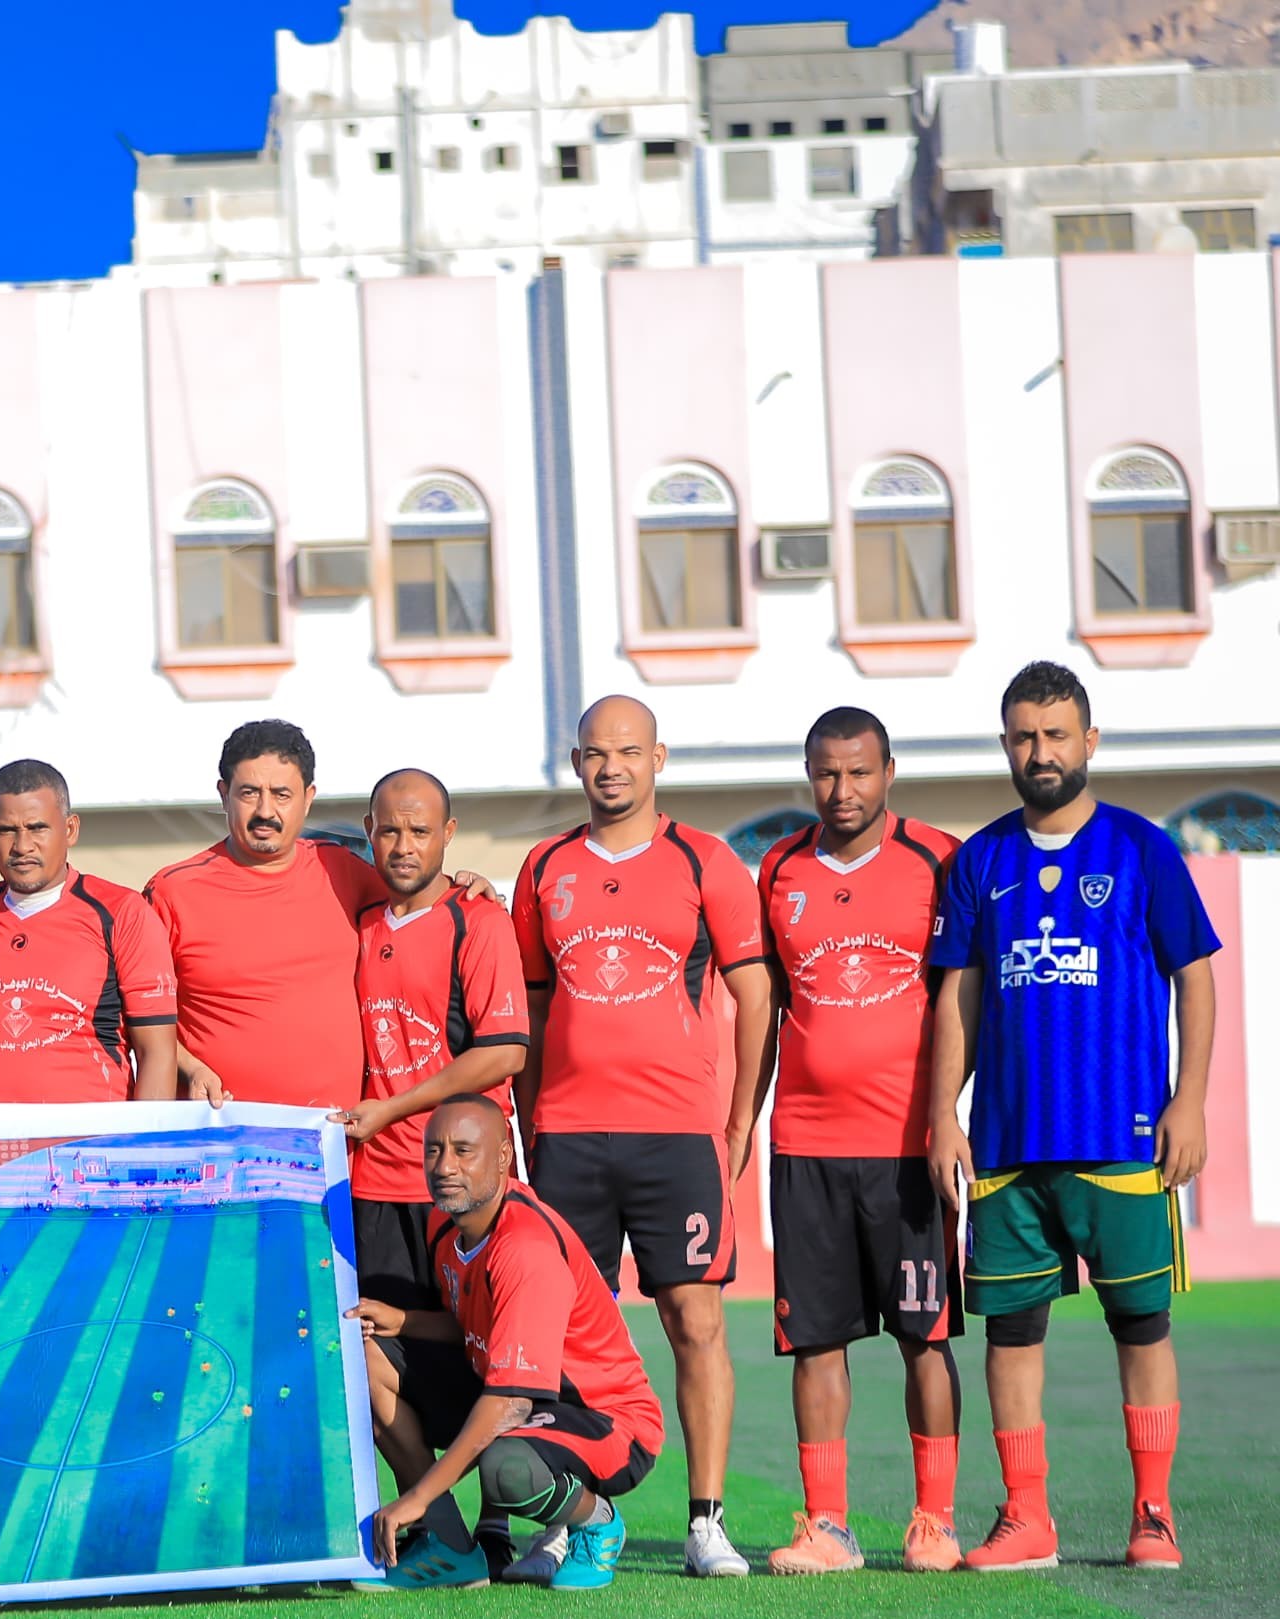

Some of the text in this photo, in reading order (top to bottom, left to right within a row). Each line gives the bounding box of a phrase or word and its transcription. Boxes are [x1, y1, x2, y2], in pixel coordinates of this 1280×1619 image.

[550, 874, 577, 921] 5
[787, 891, 807, 924] 7
[588, 925, 631, 941] الجوهرة
[828, 933, 870, 952] الجوهرة
[35, 978, 87, 1015] بصريات
[685, 1212, 712, 1265] 2
[899, 1259, 941, 1312] 11
